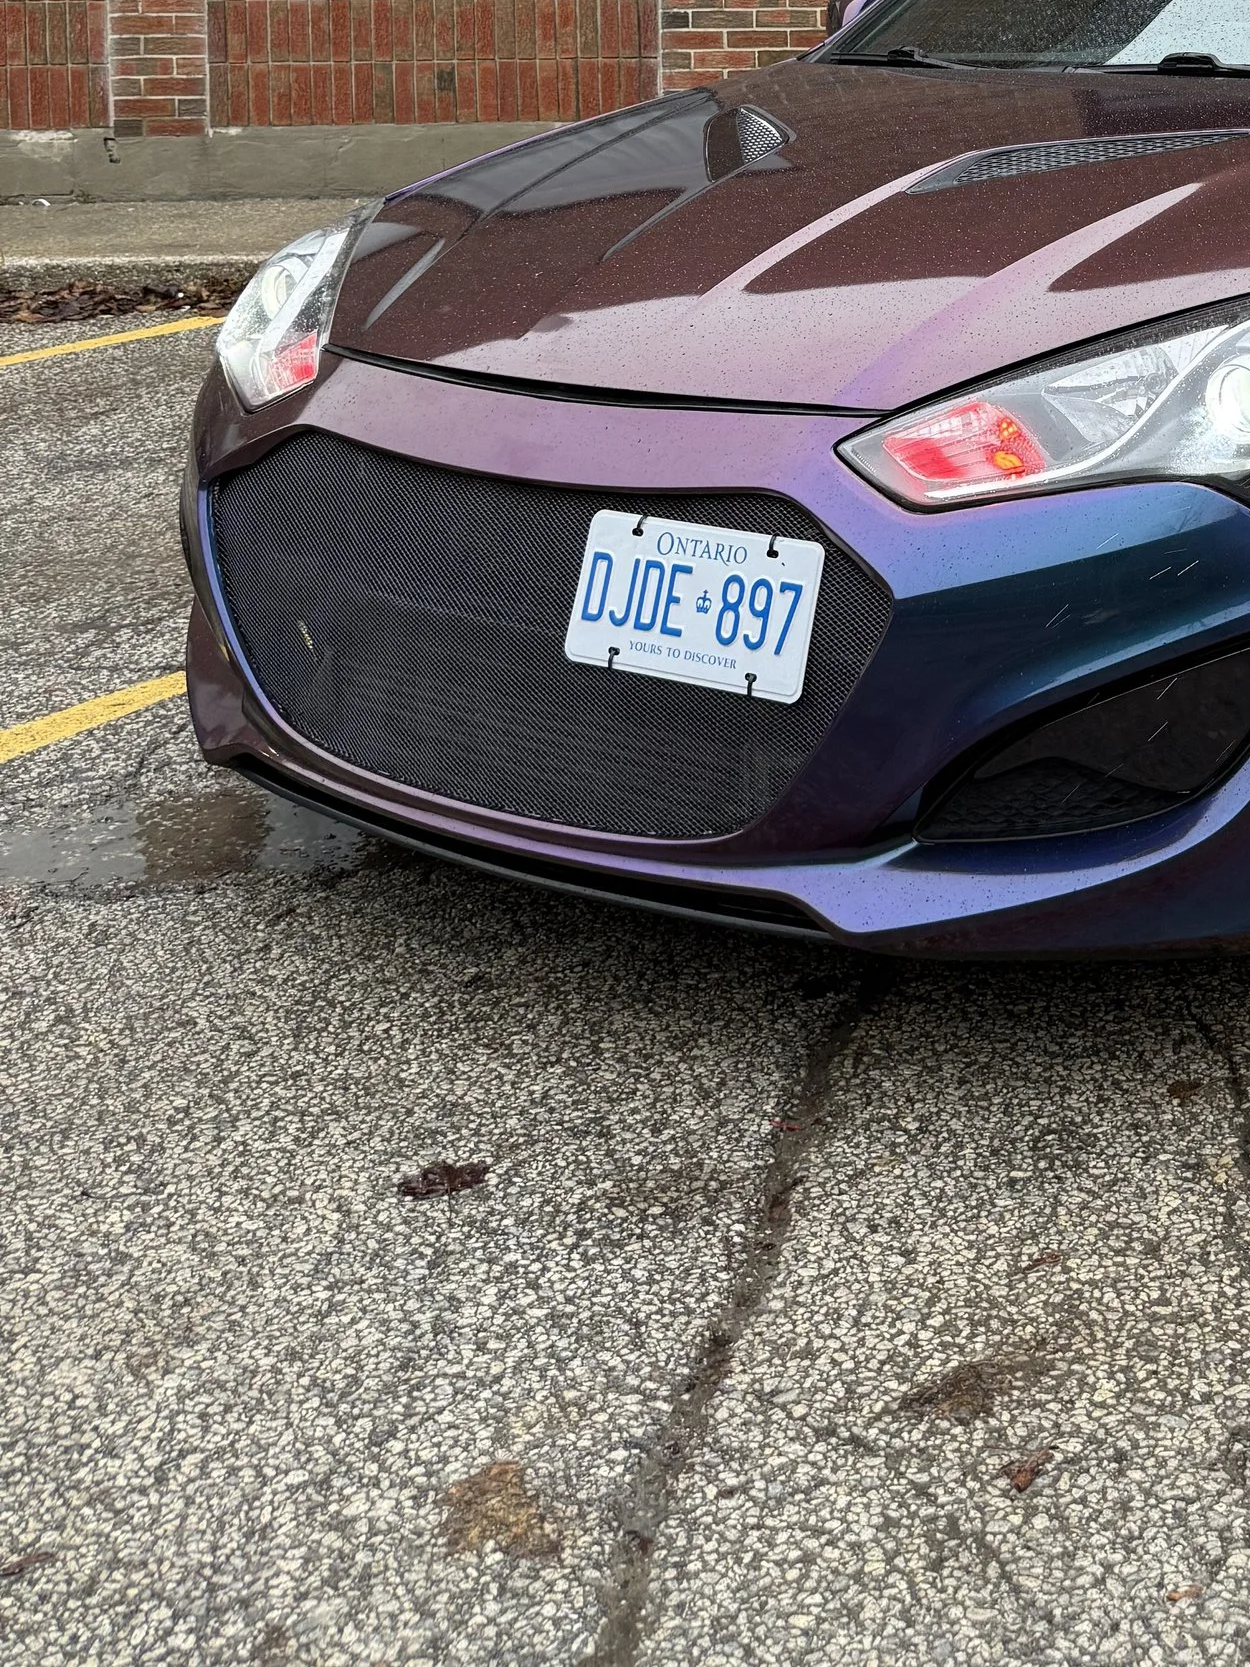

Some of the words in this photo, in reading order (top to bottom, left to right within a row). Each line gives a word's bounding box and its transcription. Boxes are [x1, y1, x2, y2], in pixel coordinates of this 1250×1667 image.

[657, 531, 748, 566] ONTARIO
[581, 551, 693, 637] DJDE
[715, 574, 803, 656] 897
[629, 640, 663, 656] YOURS
[666, 647, 681, 659] TO
[683, 649, 737, 670] DISCOVER
